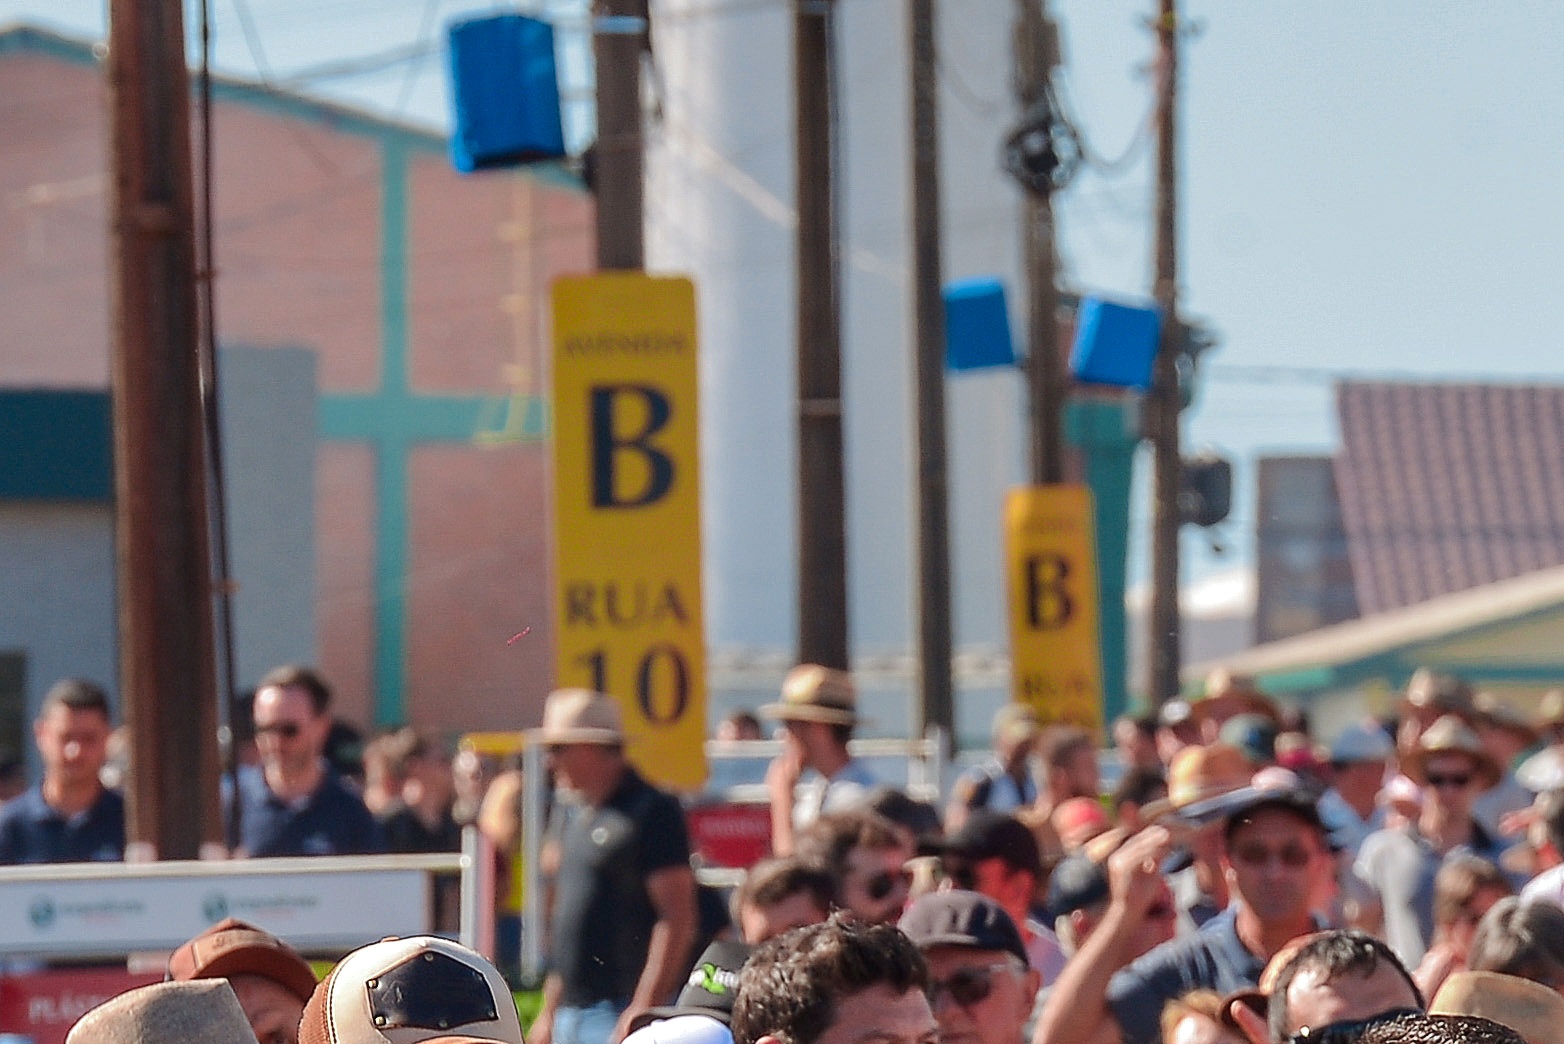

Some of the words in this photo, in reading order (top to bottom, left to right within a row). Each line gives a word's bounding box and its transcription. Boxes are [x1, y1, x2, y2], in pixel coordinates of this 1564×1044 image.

[589, 383, 675, 508] B
[566, 583, 689, 628] RUA
[1026, 552, 1074, 630] B
[572, 646, 691, 726] 10
